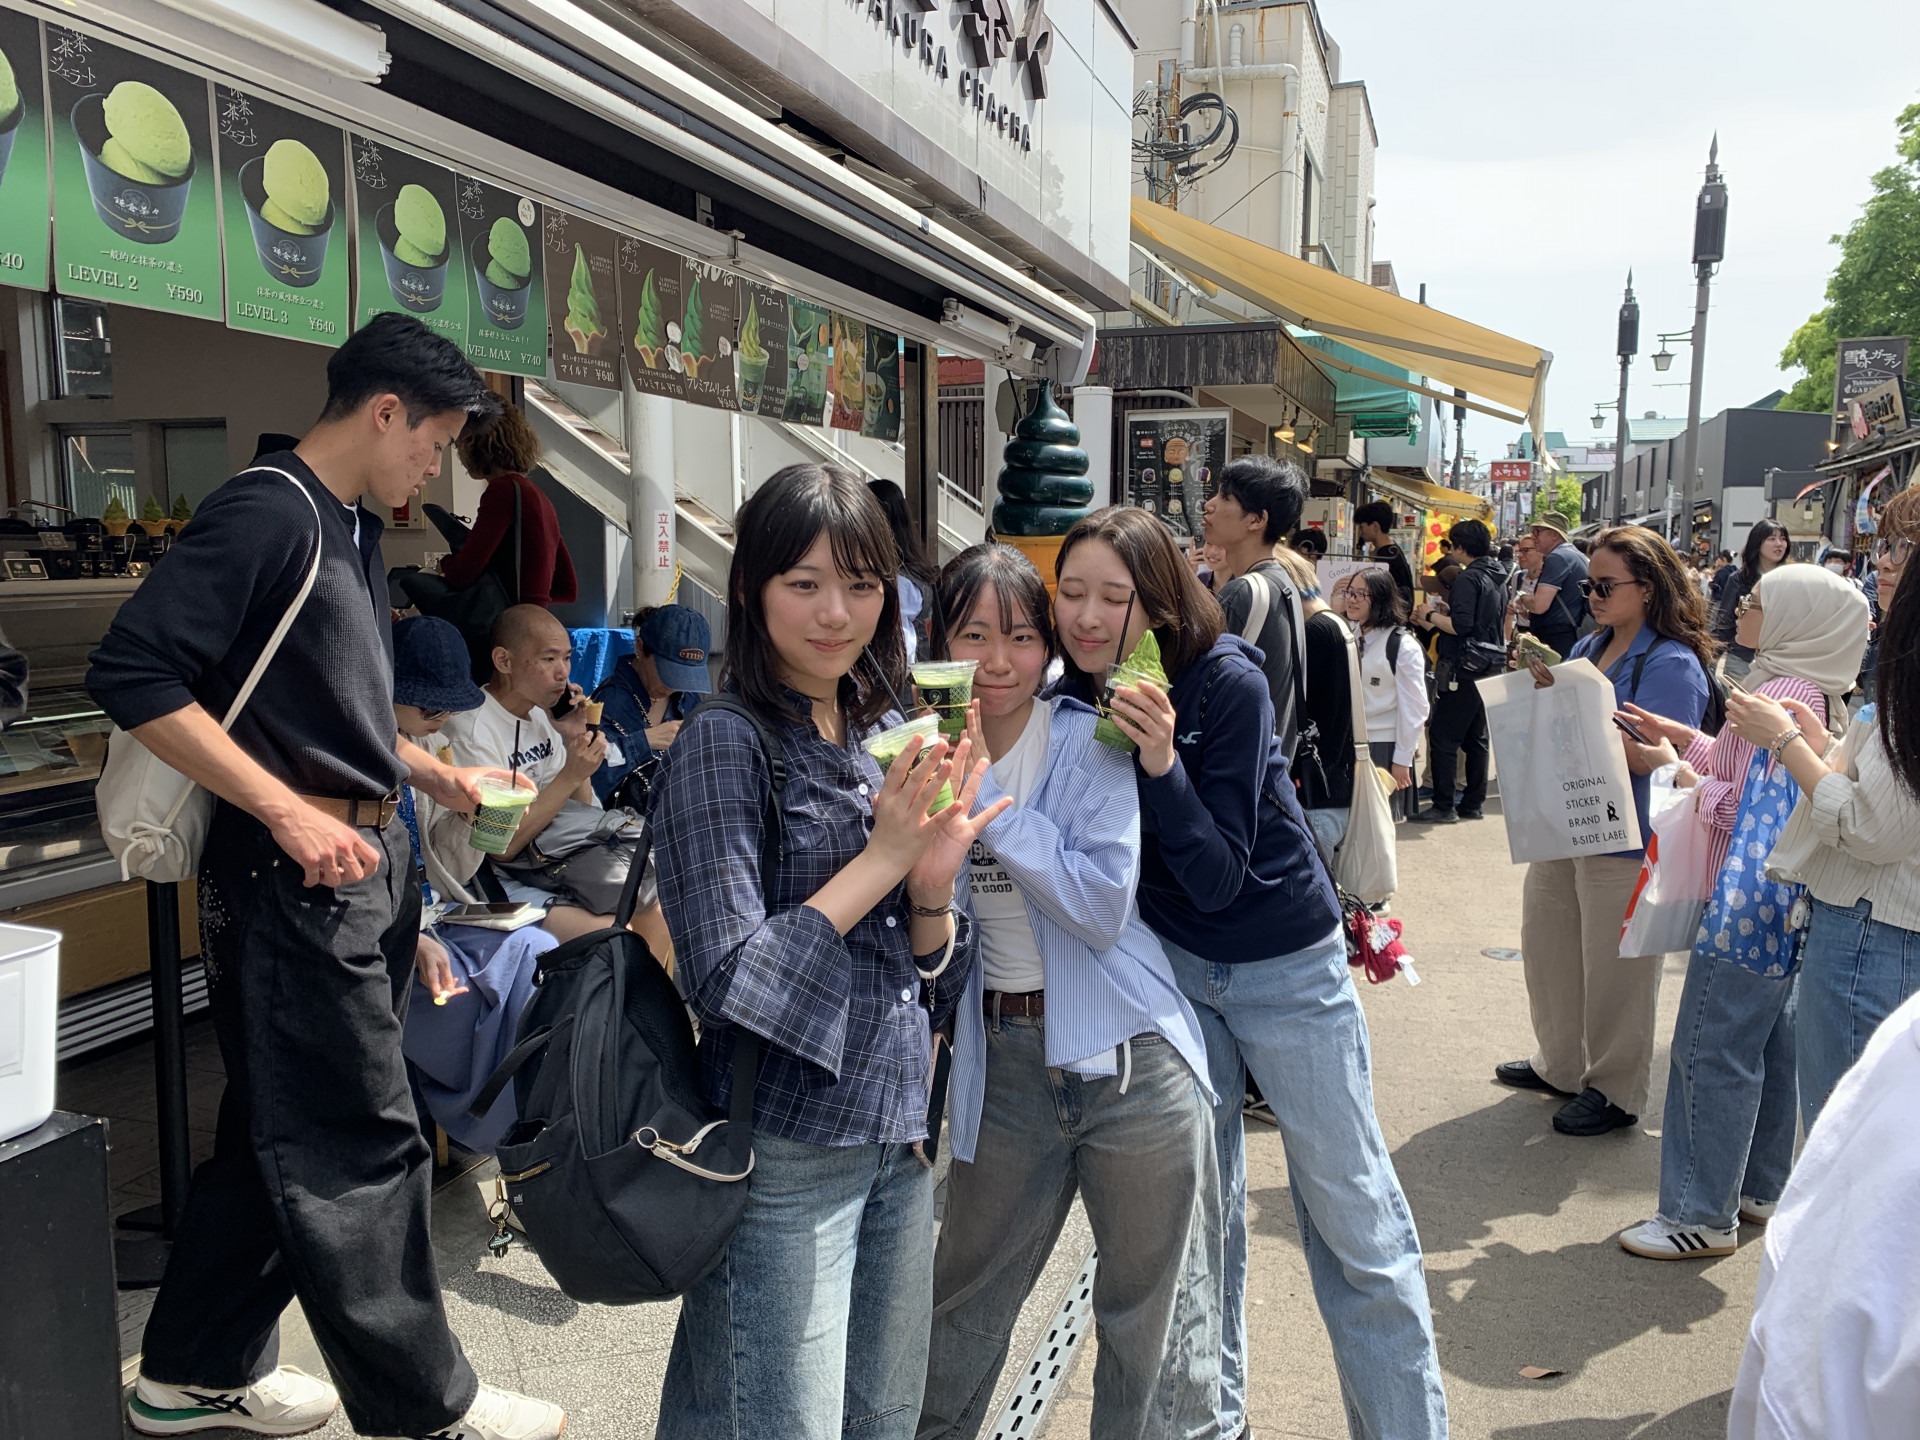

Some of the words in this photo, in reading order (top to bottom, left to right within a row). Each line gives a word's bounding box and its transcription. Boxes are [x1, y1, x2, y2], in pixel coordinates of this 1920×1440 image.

[852, 0, 948, 78] AKURA
[960, 68, 1030, 151] CHACHA
[100, 249, 184, 274] 一般的な抹茶の濃さ
[67, 263, 125, 288] LEVEL
[128, 275, 138, 291] 2
[166, 283, 204, 303] ¥590
[760, 294, 784, 312] フロート
[236, 301, 278, 322] LEVEL
[281, 310, 288, 324] 3
[308, 316, 335, 334] ¥640
[468, 344, 486, 357] VEL
[489, 347, 511, 361] MAX
[520, 352, 541, 366] ¥740
[560, 364, 588, 378] マイルド
[687, 378, 731, 397] プレミアムリッチ
[658, 512, 669, 567] 立入禁止
[1563, 776, 1607, 791] ORIGINAL
[1566, 796, 1601, 809] STICKER
[1568, 815, 1600, 827] BRAND
[1572, 833, 1600, 845] B-SIDE
[1603, 830, 1627, 841] LABEL
[982, 883, 1012, 893] GOOD
